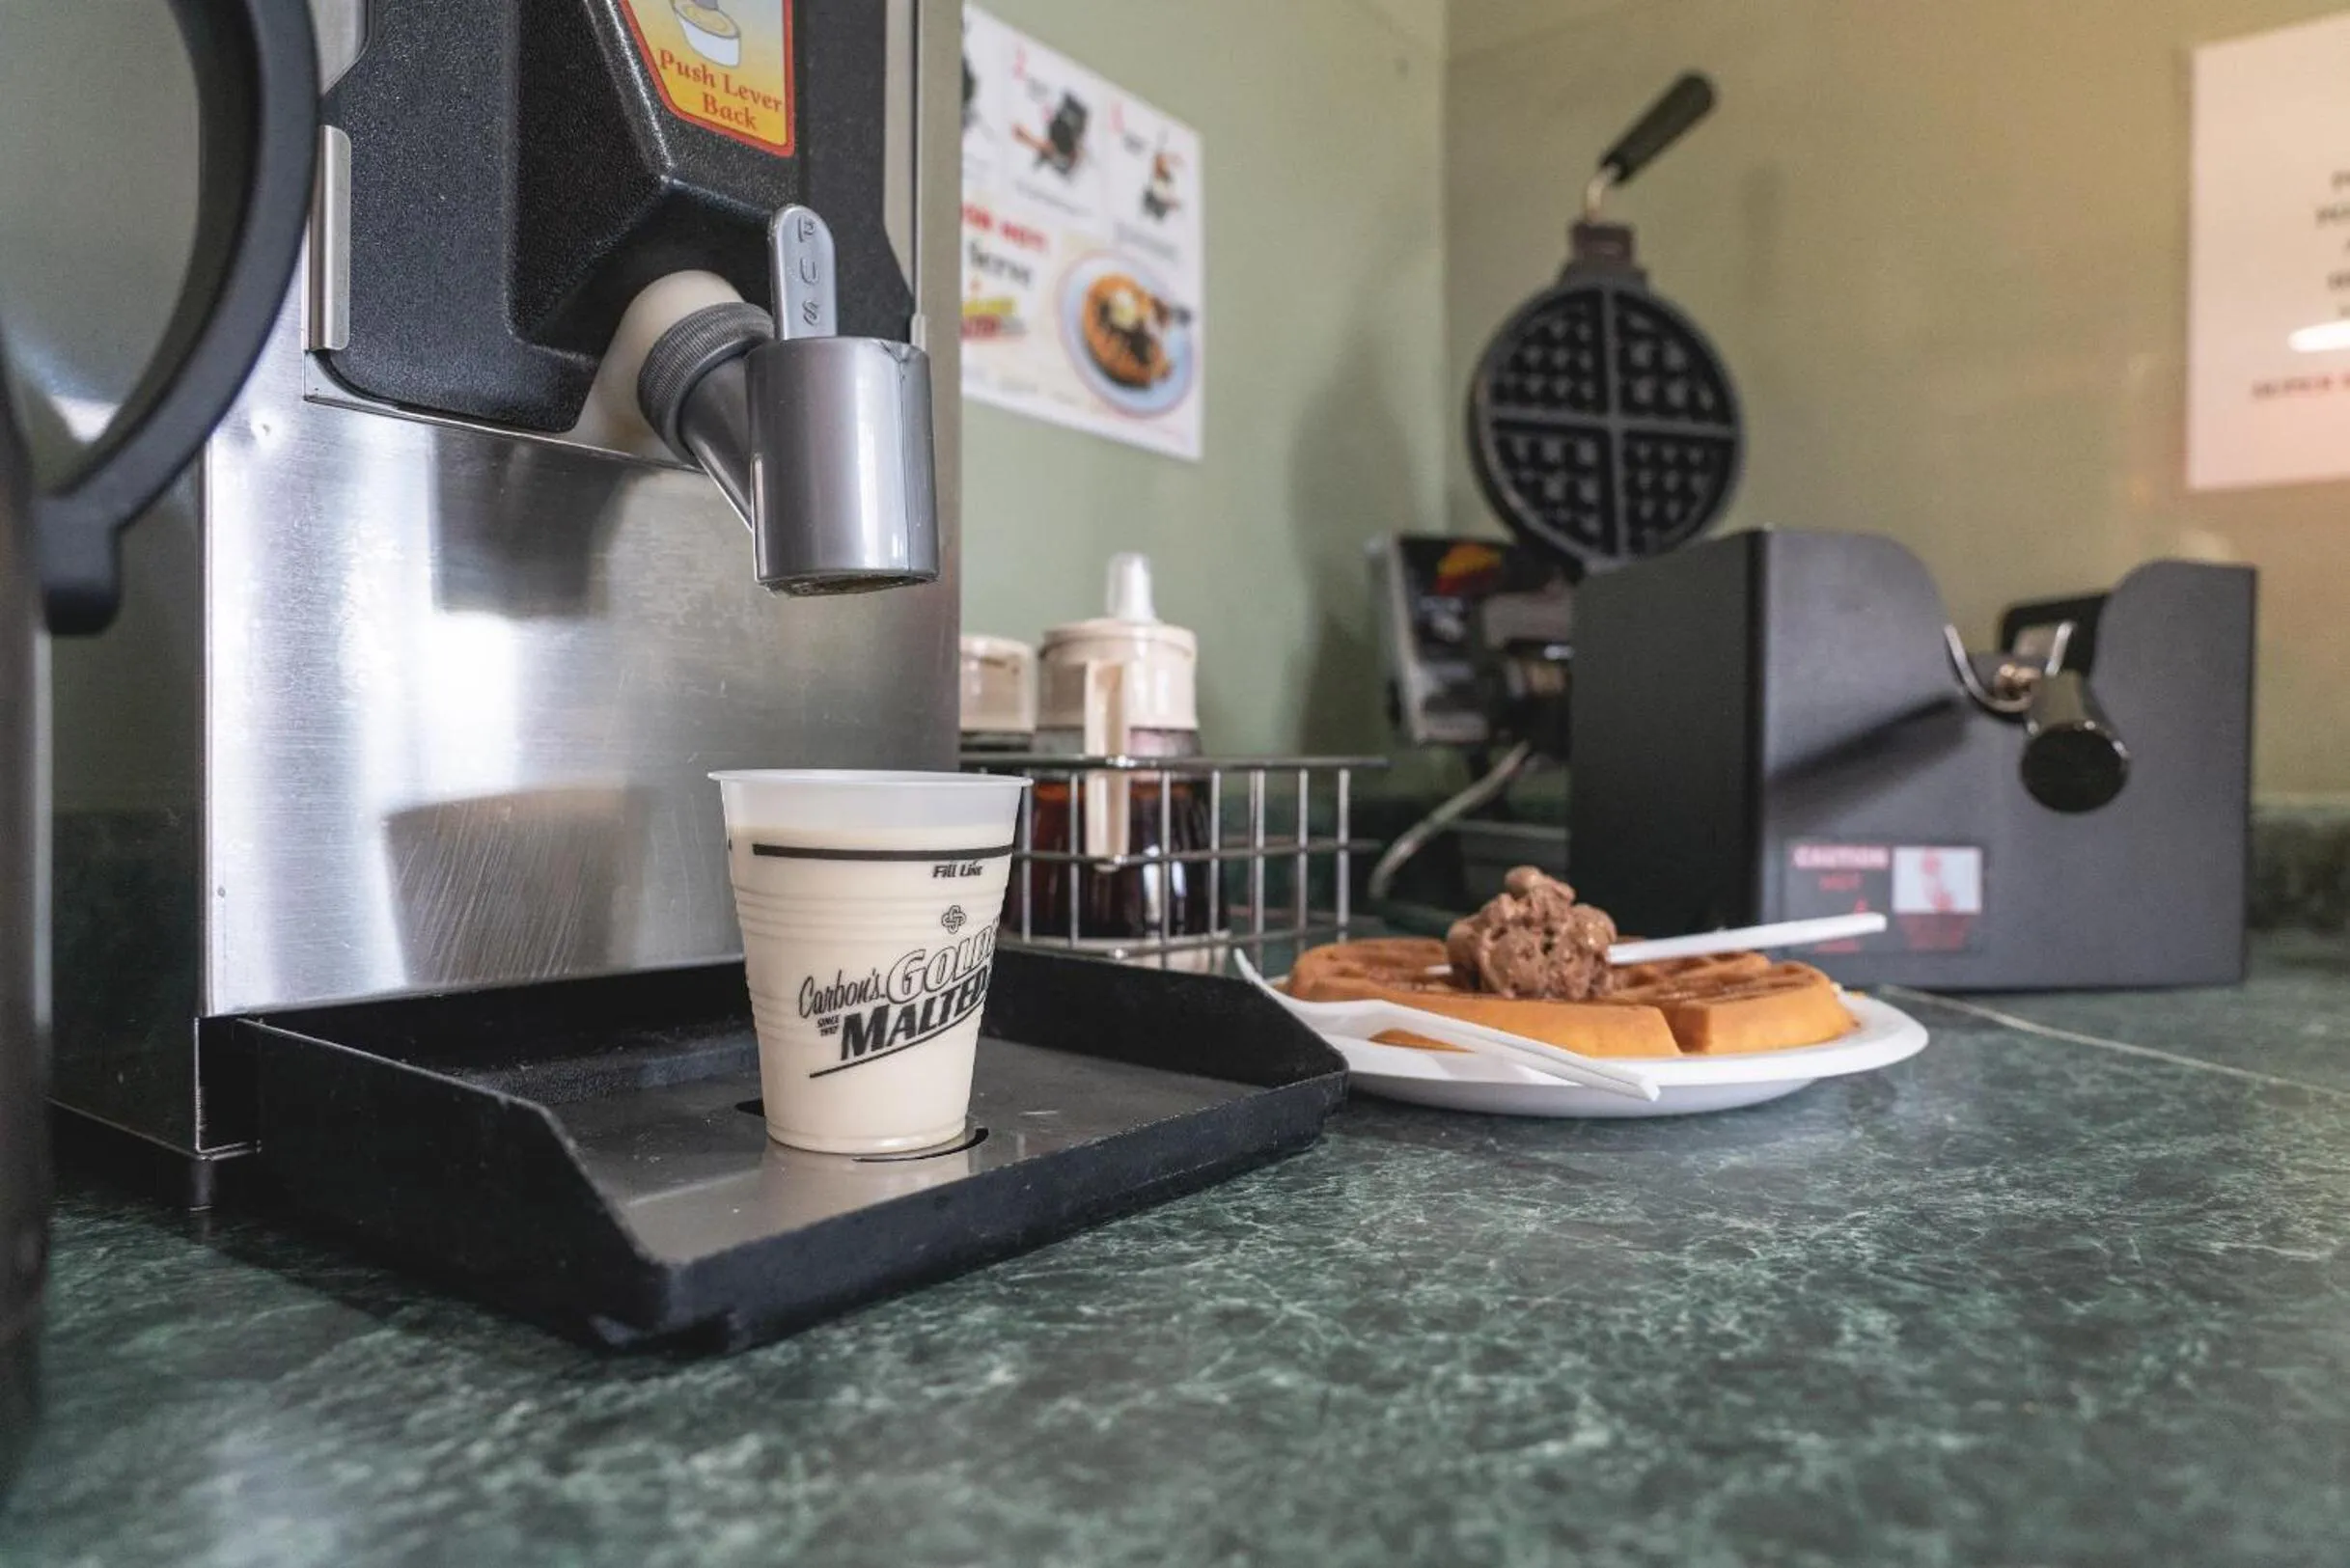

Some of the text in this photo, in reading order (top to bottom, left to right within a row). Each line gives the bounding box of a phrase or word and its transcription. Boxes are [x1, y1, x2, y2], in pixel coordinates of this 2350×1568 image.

[659, 48, 783, 113] Push Lever
[702, 92, 758, 131] Back
[797, 215, 818, 327] PUS
[932, 864, 957, 878] Fill
[799, 924, 994, 1019] Carbon's GOLD
